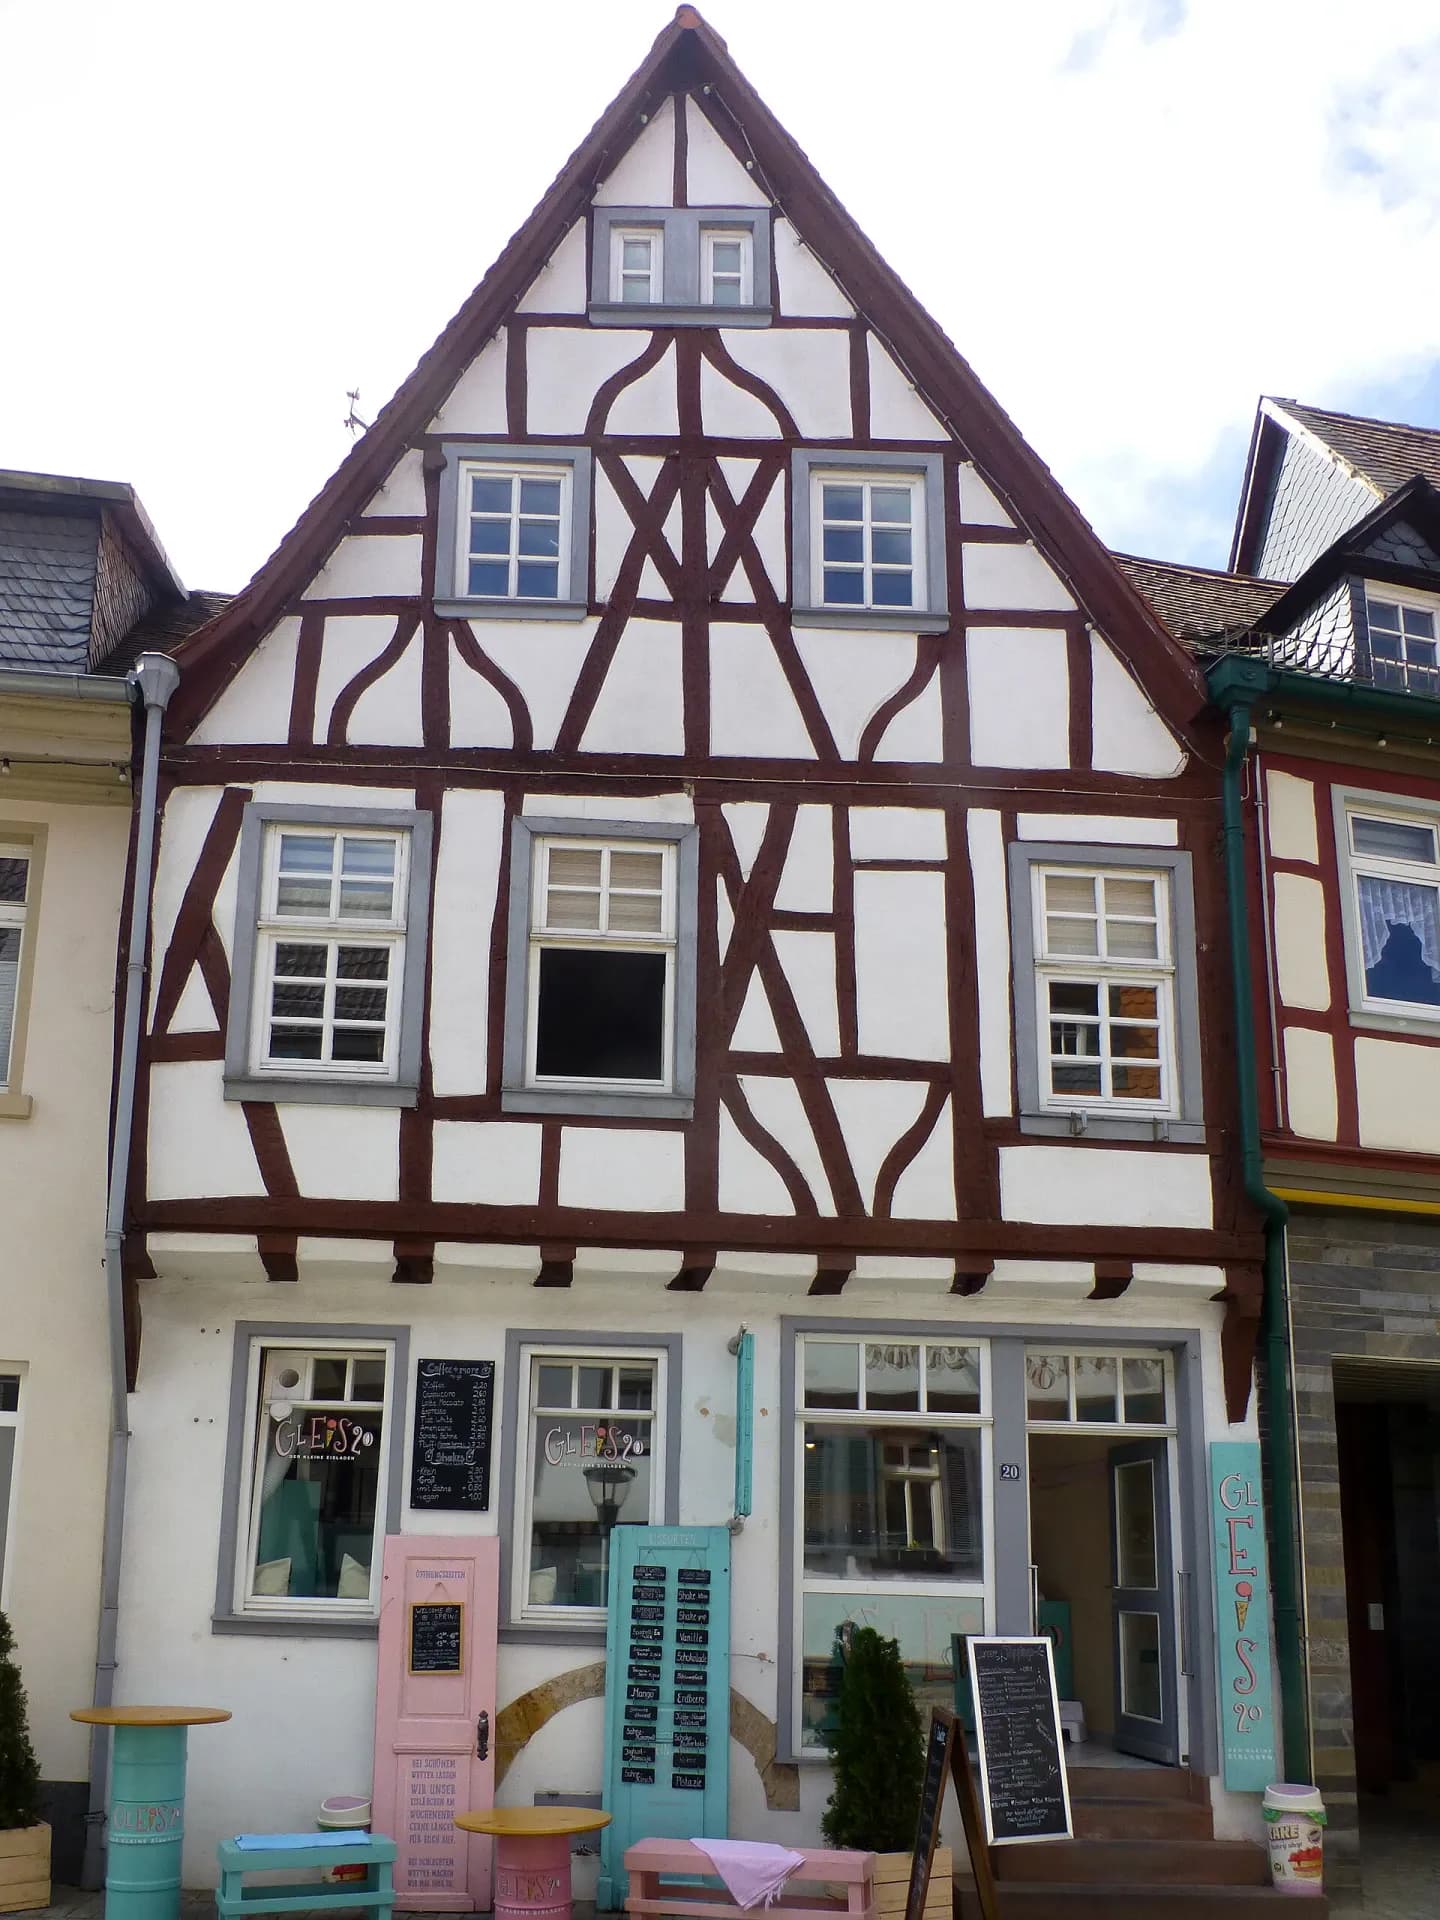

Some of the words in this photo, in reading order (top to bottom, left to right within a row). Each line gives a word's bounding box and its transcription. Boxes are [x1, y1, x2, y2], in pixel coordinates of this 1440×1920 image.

[427, 1363, 452, 1375] Coffee
[1002, 1465, 1018, 1479] 20
[680, 1632, 703, 1643] Vanille
[631, 1687, 655, 1699] Mango
[677, 1692, 705, 1704] Erdbeere
[411, 1784, 426, 1794] WIR
[430, 1784, 456, 1794] UNSER
